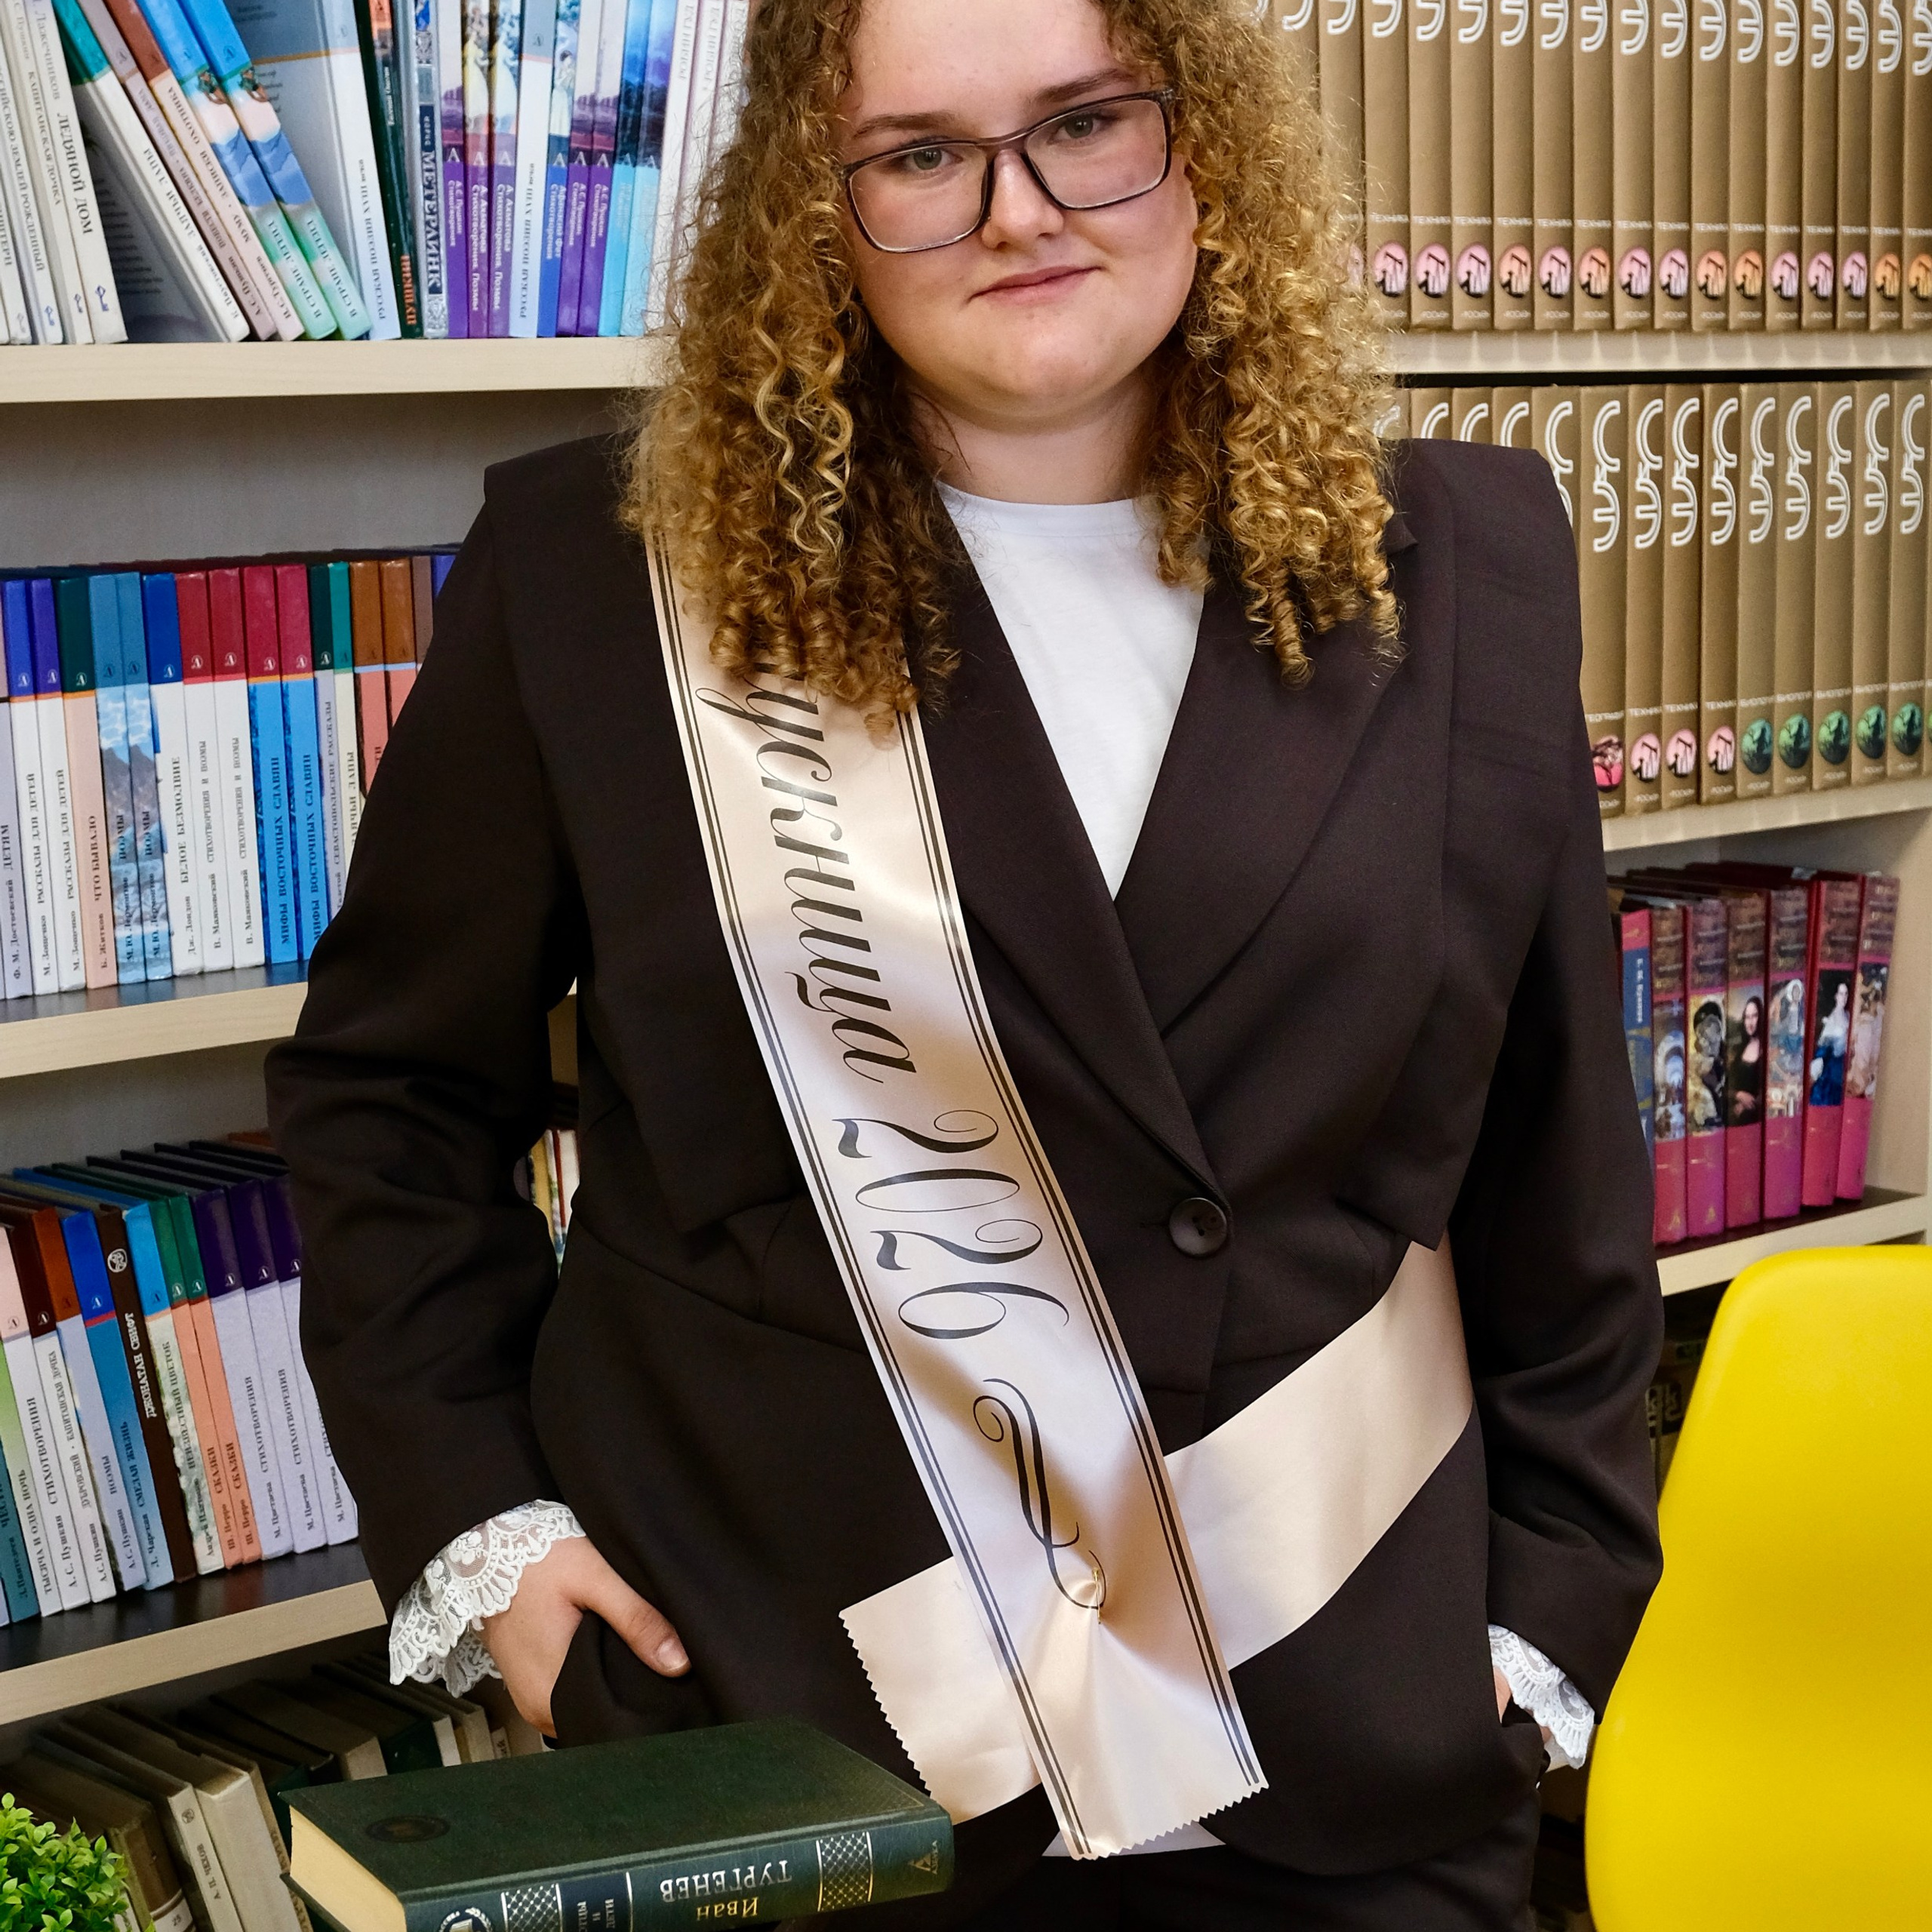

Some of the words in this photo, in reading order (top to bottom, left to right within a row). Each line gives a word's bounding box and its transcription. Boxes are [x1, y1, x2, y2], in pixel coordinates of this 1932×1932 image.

[27, 70, 54, 161] КАПИТАНСКАЯ
[46, 163, 63, 205] ДОЧКА
[34, 9, 63, 100] Лажечников
[56, 110, 86, 192] ЛЕДЯНОЙ
[74, 195, 93, 235] ДОМ
[166, 86, 202, 145] ОХОТНИКА
[141, 146, 168, 187] ЛАПЫ
[198, 149, 229, 199] ЗАПИСКИ
[9, 143, 28, 190] ЗЕМЛЕЙ
[20, 192, 45, 271] РОЖДЕННЫЙ
[165, 189, 197, 240] ЗАЯЧЬИ
[232, 212, 251, 242] МУМУ
[420, 150, 441, 288] МЕТЕРЛИНК
[479, 198, 488, 253] Ахматова
[503, 198, 512, 251] Ахматова
[266, 219, 294, 264] ЛЕГЕНД
[305, 219, 332, 263] ЛЕГЕНД
[364, 217, 378, 264] ПОЭЗИЯ
[521, 219, 531, 264] ПОЭЗИЯ
[290, 264, 317, 309] СТРАНЕ
[327, 264, 353, 306] СТРАНЕ
[371, 267, 386, 318] РУССКАЯ
[398, 254, 417, 325] ПУШКИН
[471, 272, 479, 310] Поэмы
[493, 272, 502, 309] Поэмы
[518, 268, 530, 318] РУССКАЯ
[324, 701, 334, 755] РАССКАЗЫ
[198, 740, 208, 771] ПОЭМЫ
[231, 737, 240, 768] ПОЭМЫ
[346, 752, 355, 789] ЛАПЫ
[26, 773, 38, 812] ДЕТЕЙ
[55, 769, 67, 808] ДЕТЕЙ
[171, 757, 185, 835] БЕЗМОЛВИЕ
[270, 756, 281, 809] СЛАВЯН
[302, 754, 313, 806] СЛАВЯН
[31, 817, 40, 841] ДЛЯ
[60, 812, 69, 836] ДЛЯ
[141, 811, 152, 855] ПОЭМЫ
[202, 790, 214, 862] СТИХОТВОРЕНИЯ
[235, 786, 247, 858] СТИХОТВОРЕНИЯ
[328, 761, 340, 864] СЕВАСТОПОЛЬСКИЕ
[0, 824, 13, 871] ДЕТЯМ
[88, 815, 100, 870] БЫВАЛО
[115, 814, 126, 860] ПОЭМЫ
[274, 815, 287, 896] ВОСТОЧНЫХ
[306, 812, 318, 892] ВОСТОЧНЫХ
[32, 845, 45, 903] РАССКАЗЫ
[62, 841, 74, 899] РАССКАЗЫ
[178, 841, 189, 883] БЕЛОЕ
[93, 875, 102, 900] ЧТО
[208, 872, 220, 934] Маяковский
[240, 869, 251, 929] Маяковский
[5, 879, 19, 946] Достоевский
[69, 911, 78, 955] Зощенко
[97, 913, 106, 954] Житков
[183, 896, 193, 931] Лондон
[279, 903, 290, 944] МИФЫ
[311, 900, 321, 939] МИФЫ
[39, 915, 49, 960] Зощенко
[695, 663, 917, 1084] ускница
[832, 1109, 1070, 1340] 2026
[124, 1312, 141, 1350] СВИФТ
[47, 1350, 62, 1379] ДОЧКА
[133, 1352, 157, 1418] ДЖОНАТАН
[161, 1341, 179, 1386] ЦВЕТОК
[54, 1381, 75, 1441] КАПИТАНСКАЯ
[171, 1387, 196, 1469] НЕИЗВЕСТНЫЙ
[244, 1376, 269, 1473] СТИХОТВОРЕНИЯ
[276, 1368, 303, 1465] СТИХОТВОРЕНИЯ
[25, 1397, 59, 1505] СТИХОТВОРЕНИЯ
[119, 1421, 136, 1461] ЖИЗНЬ
[16, 1469, 31, 1500] НОЧЬ
[69, 1453, 91, 1509] ДУБРОВСКИЙ
[100, 1454, 117, 1494] ПОЭМЫ
[129, 1464, 146, 1507] СМЕЛАЯ
[206, 1447, 224, 1494] СКАЗКИ
[224, 1441, 242, 1490] СКАЗКИ
[328, 1466, 343, 1508] Цветаева
[237, 1499, 251, 1527] Перро
[264, 1481, 279, 1524] Цветаева
[297, 1473, 312, 1516] Цветаева
[24, 1503, 39, 1534] ОДНА
[52, 1514, 73, 1560] Пушкин
[114, 1508, 132, 1548] Пушкин
[140, 1513, 158, 1552] Чарская
[201, 1524, 217, 1557] Андрей
[219, 1503, 233, 1533] Перро
[87, 1521, 104, 1561] Пушкин
[35, 1549, 53, 1594] ТЫСЯЧА
[195, 1843, 212, 1875] ЧЕХОВ
[660, 1860, 792, 1903] ТУРГЕНЕВ
[697, 1897, 758, 1921] Иван
